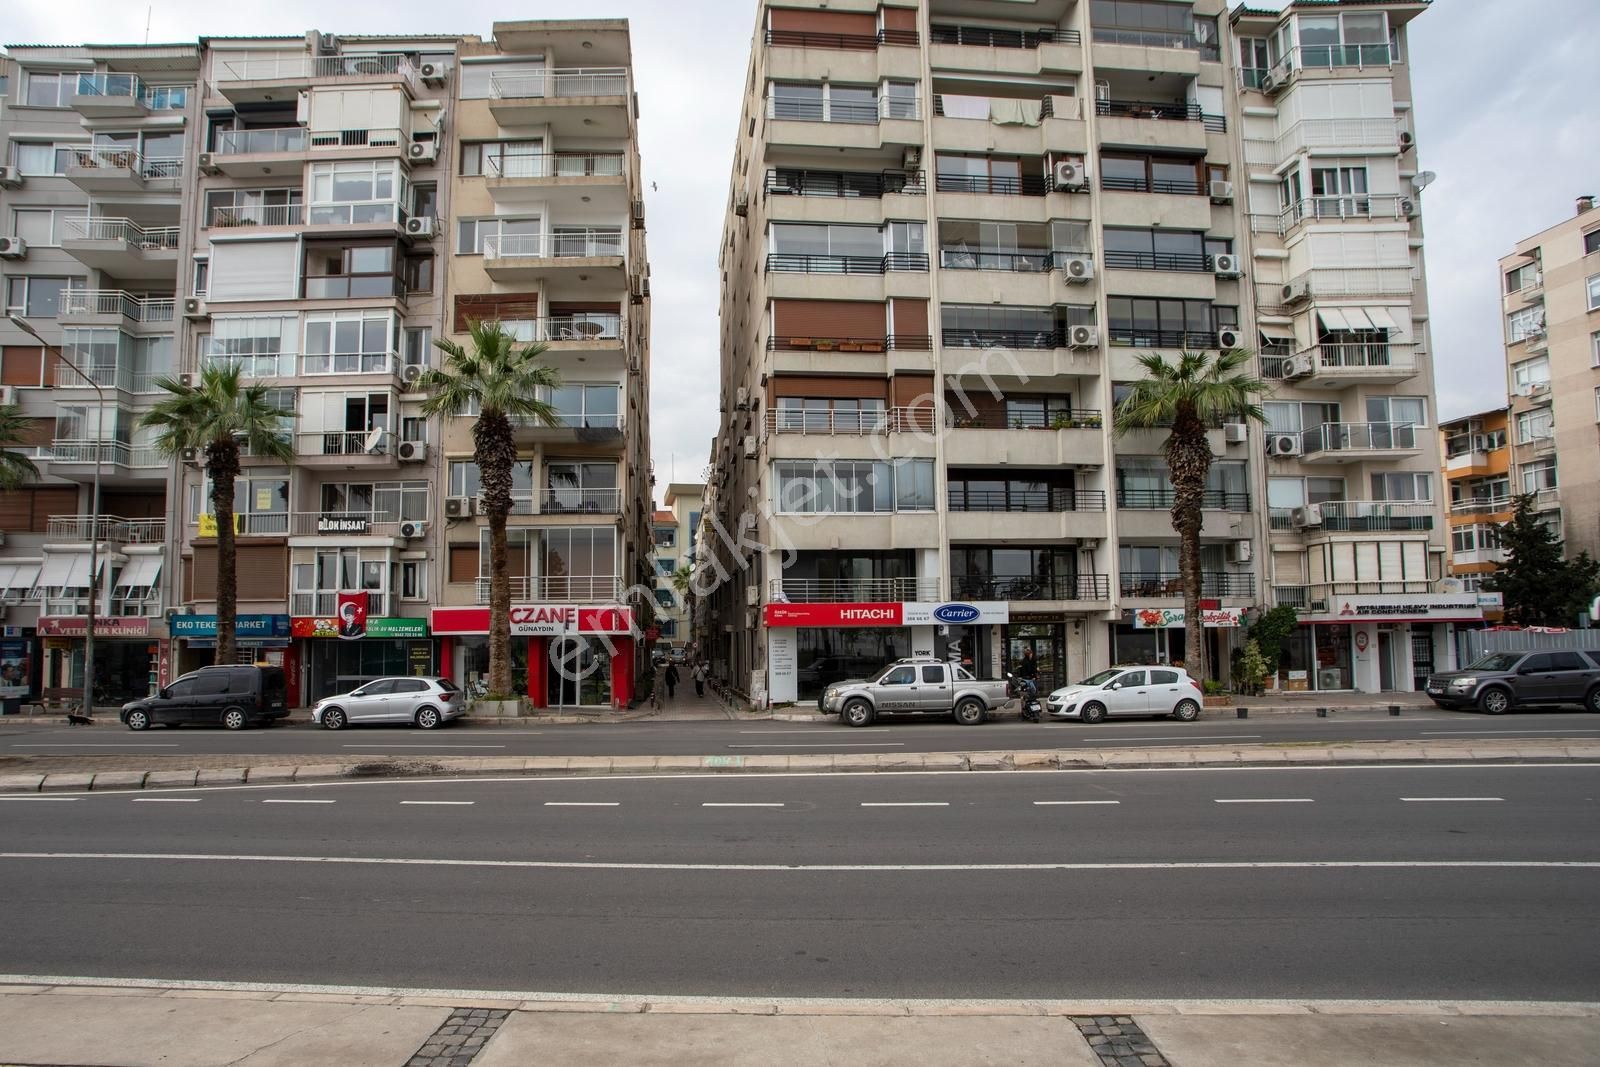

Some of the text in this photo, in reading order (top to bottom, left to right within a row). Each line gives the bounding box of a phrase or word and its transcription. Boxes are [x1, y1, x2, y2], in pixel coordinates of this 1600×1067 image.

[508, 608, 576, 624] CZANE
[840, 608, 894, 619] HITACHI
[940, 608, 974, 618] Carrier
